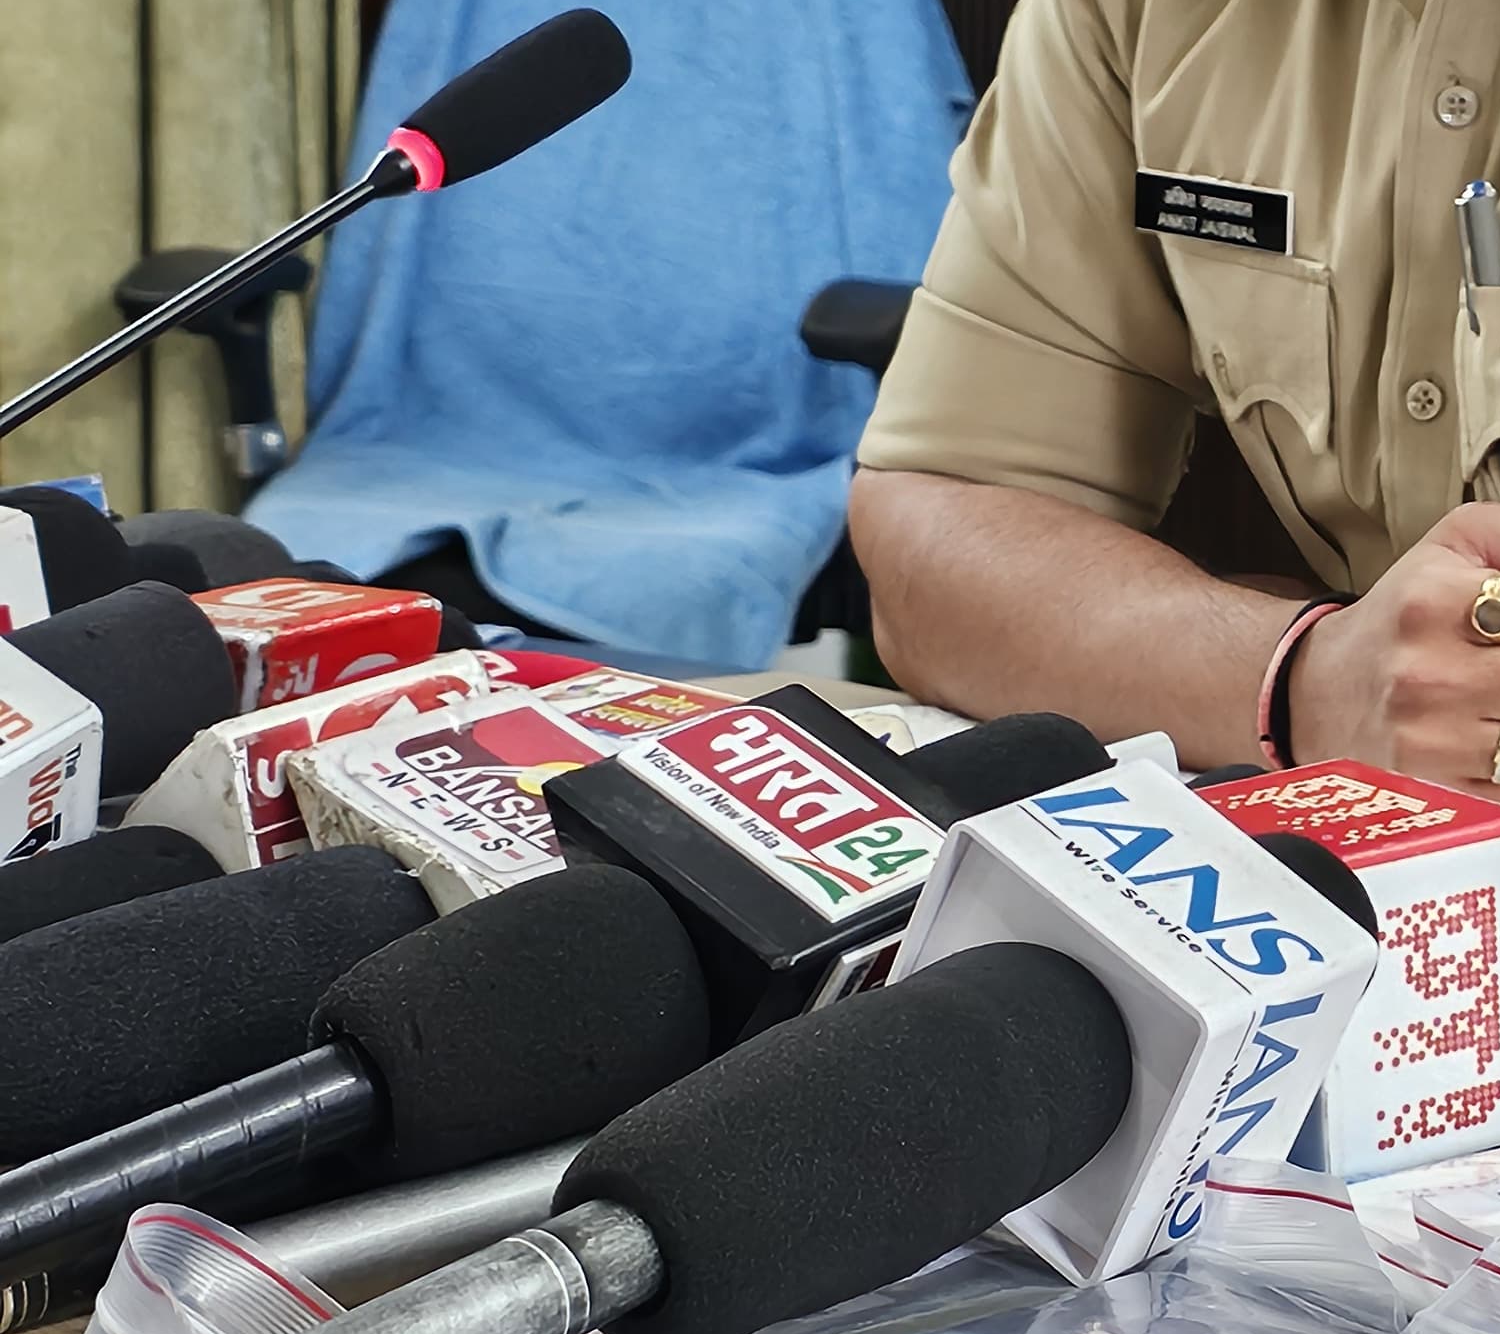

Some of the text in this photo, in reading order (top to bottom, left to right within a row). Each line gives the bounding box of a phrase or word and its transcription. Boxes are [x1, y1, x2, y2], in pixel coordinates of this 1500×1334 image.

[412, 745, 556, 849] BANSAL
[643, 748, 692, 784] Vision
[703, 789, 739, 823] New
[738, 816, 782, 849] India
[711, 715, 878, 833] भारत
[835, 826, 929, 877] 24
[1032, 786, 1325, 976] IANS
